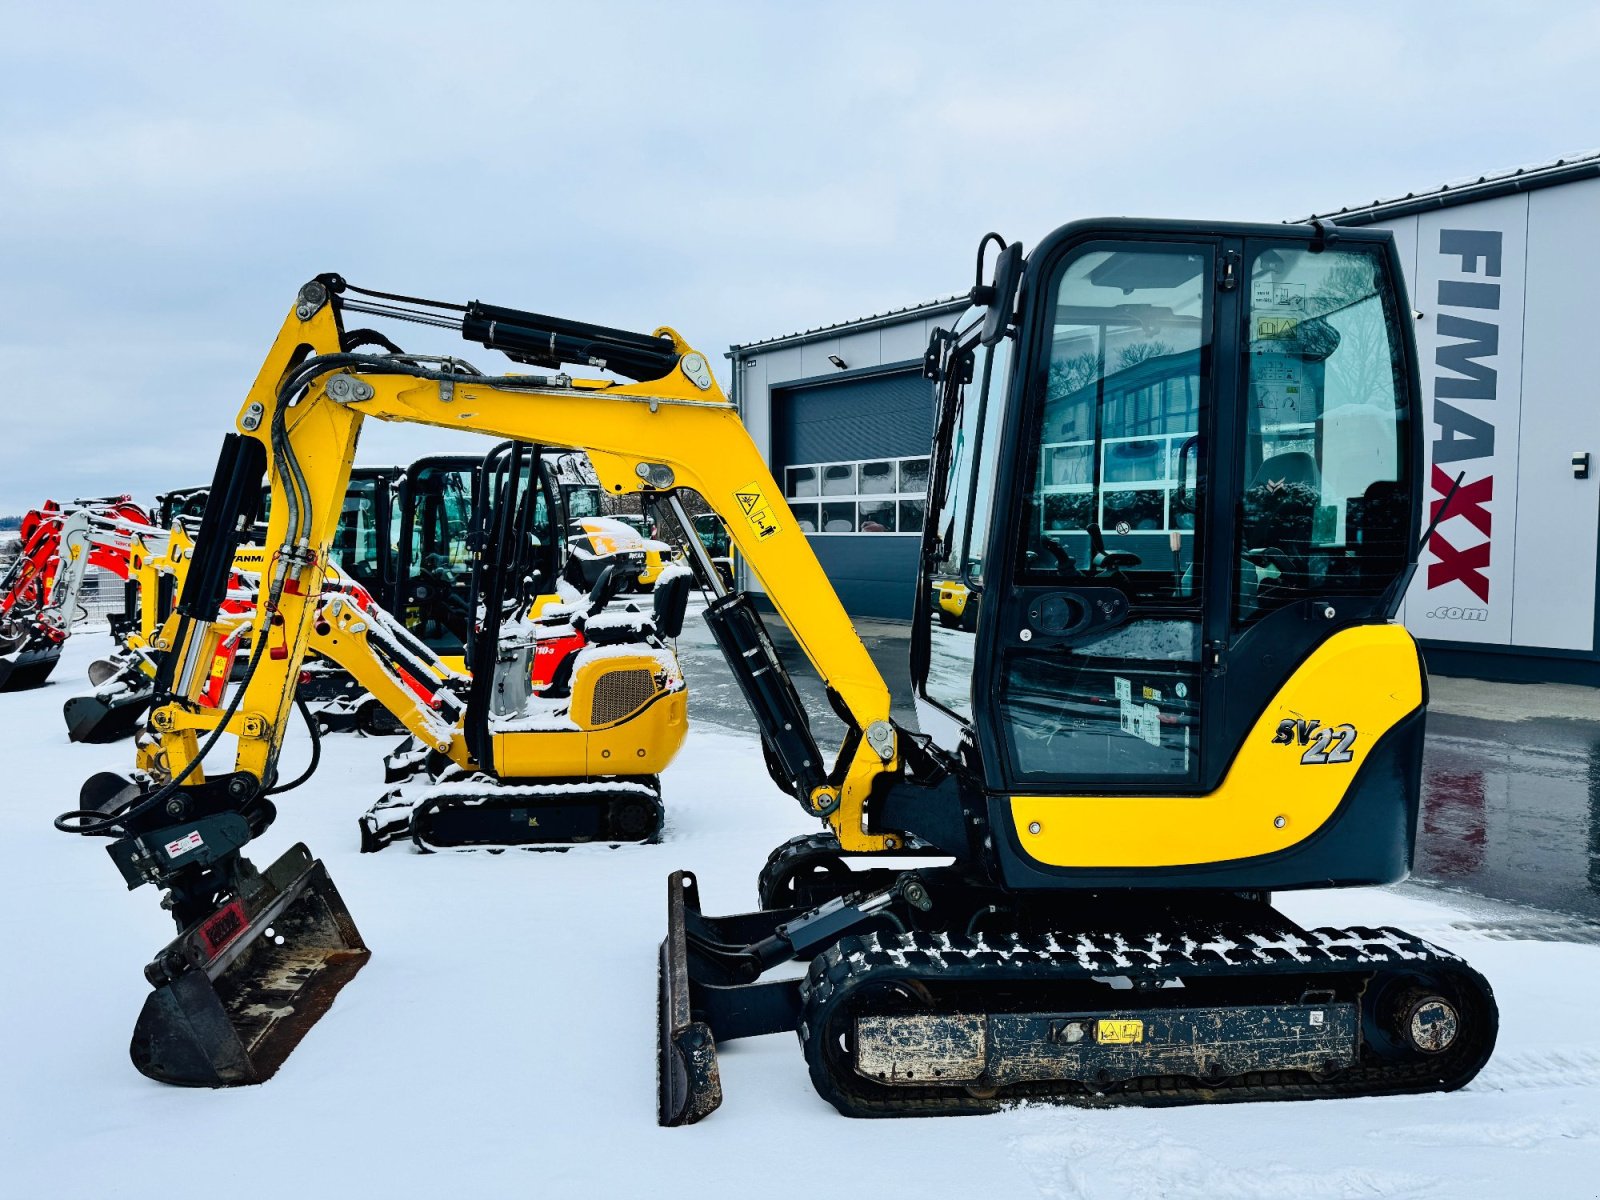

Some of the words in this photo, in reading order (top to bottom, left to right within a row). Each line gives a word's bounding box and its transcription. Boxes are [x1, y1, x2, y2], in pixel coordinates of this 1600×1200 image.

[1427, 229, 1502, 604] FIMAXX
[1426, 606, 1488, 621] .com
[1271, 719, 1358, 765] SV22
